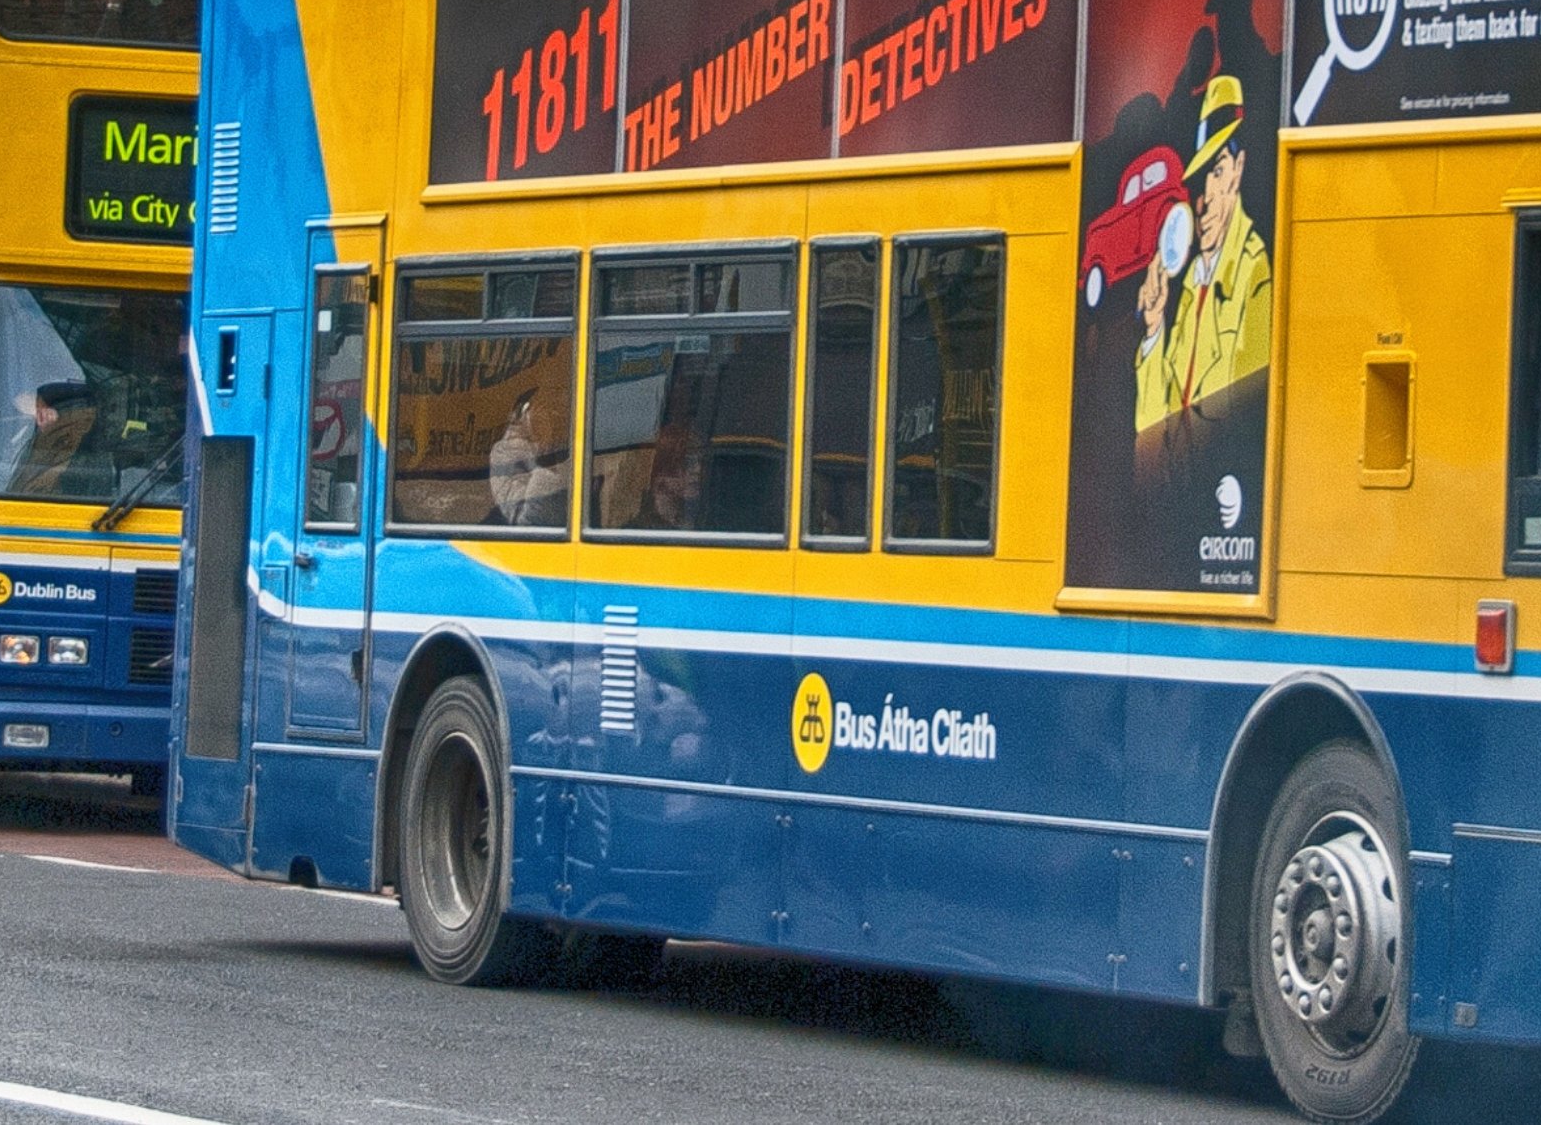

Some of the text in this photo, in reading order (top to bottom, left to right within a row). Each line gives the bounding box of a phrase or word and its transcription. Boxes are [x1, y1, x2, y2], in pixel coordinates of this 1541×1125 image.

[1402, 17, 1413, 46] &
[1415, 16, 1453, 49] texting
[1456, 13, 1486, 42] them
[1488, 11, 1517, 39] back
[1520, 8, 1538, 36] for
[624, 83, 682, 172] THE
[89, 191, 123, 221] via
[131, 194, 180, 228] City
[14, 581, 96, 601] Dublin Bus
[834, 692, 996, 759] Bus Átha Cliath
